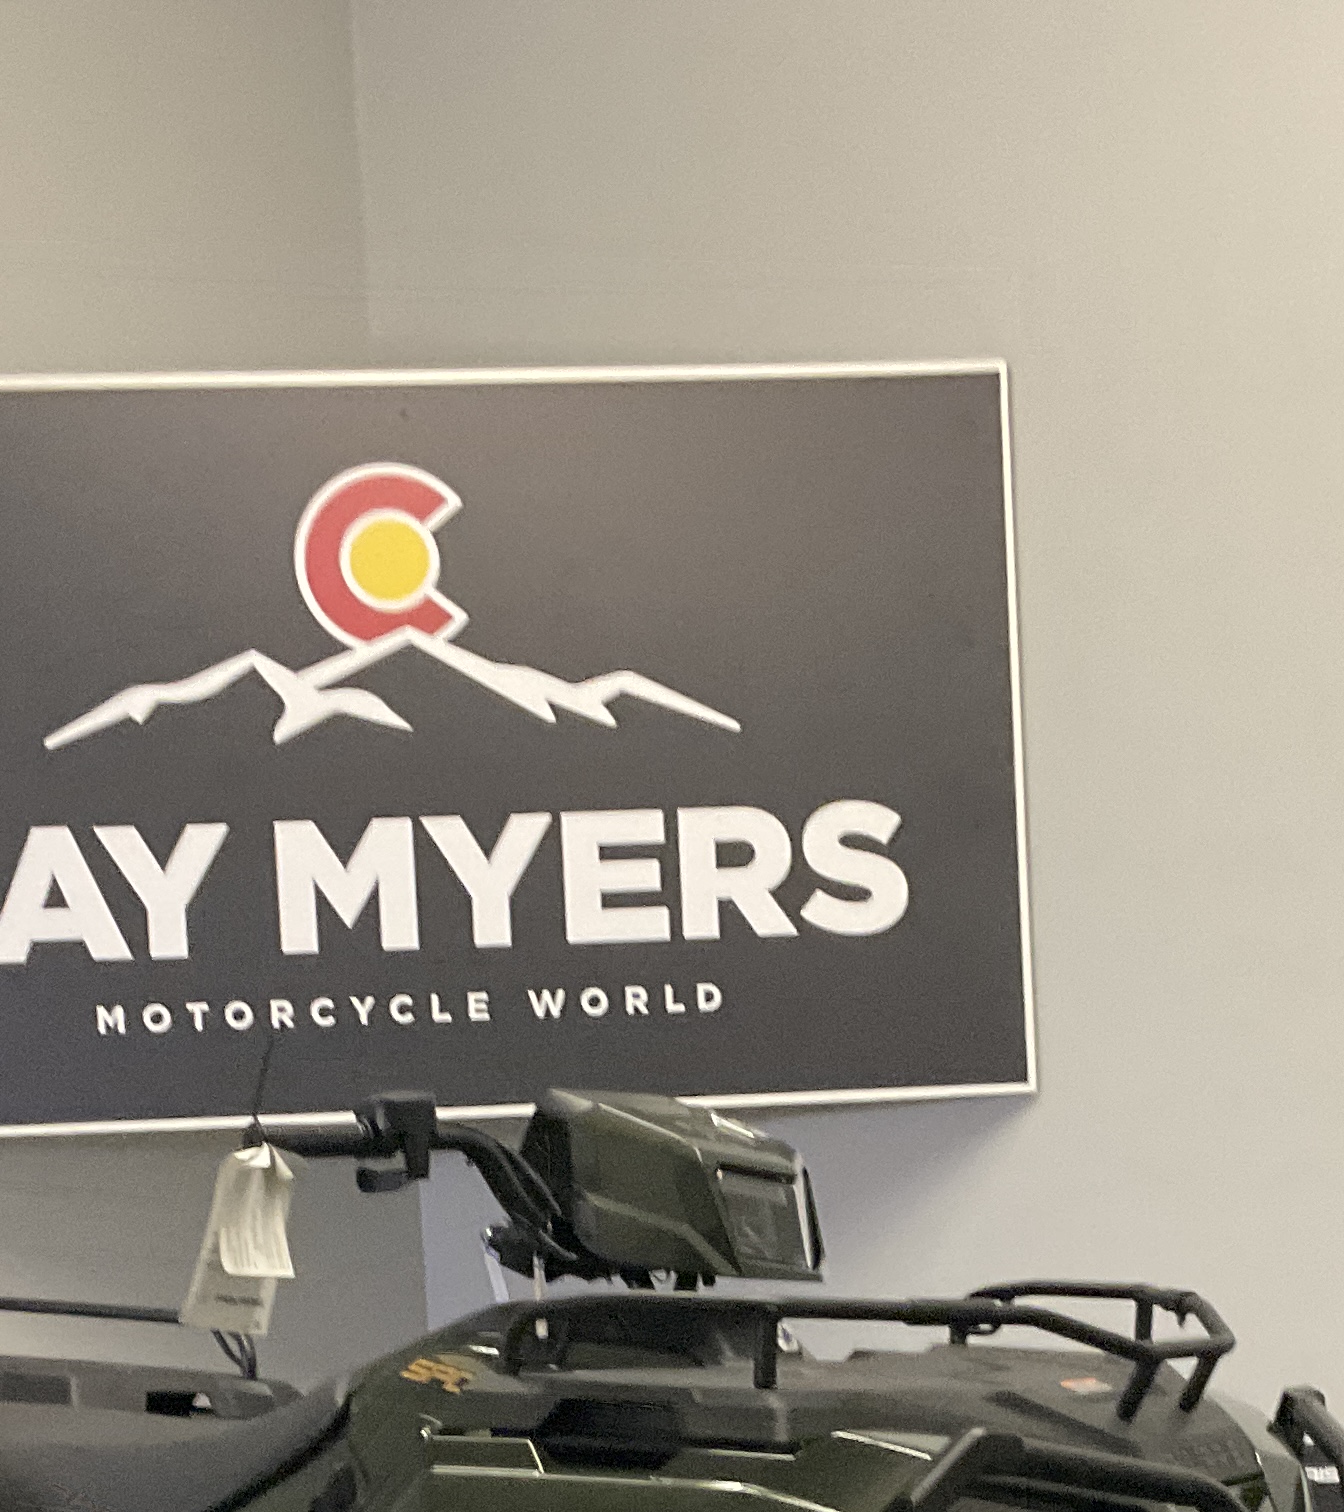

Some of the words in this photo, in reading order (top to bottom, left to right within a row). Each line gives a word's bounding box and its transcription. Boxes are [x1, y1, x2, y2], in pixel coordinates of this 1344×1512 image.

[273, 800, 908, 954] MYERS
[96, 992, 490, 1034] MOTORCYCLE
[528, 983, 721, 1018] WORLD
